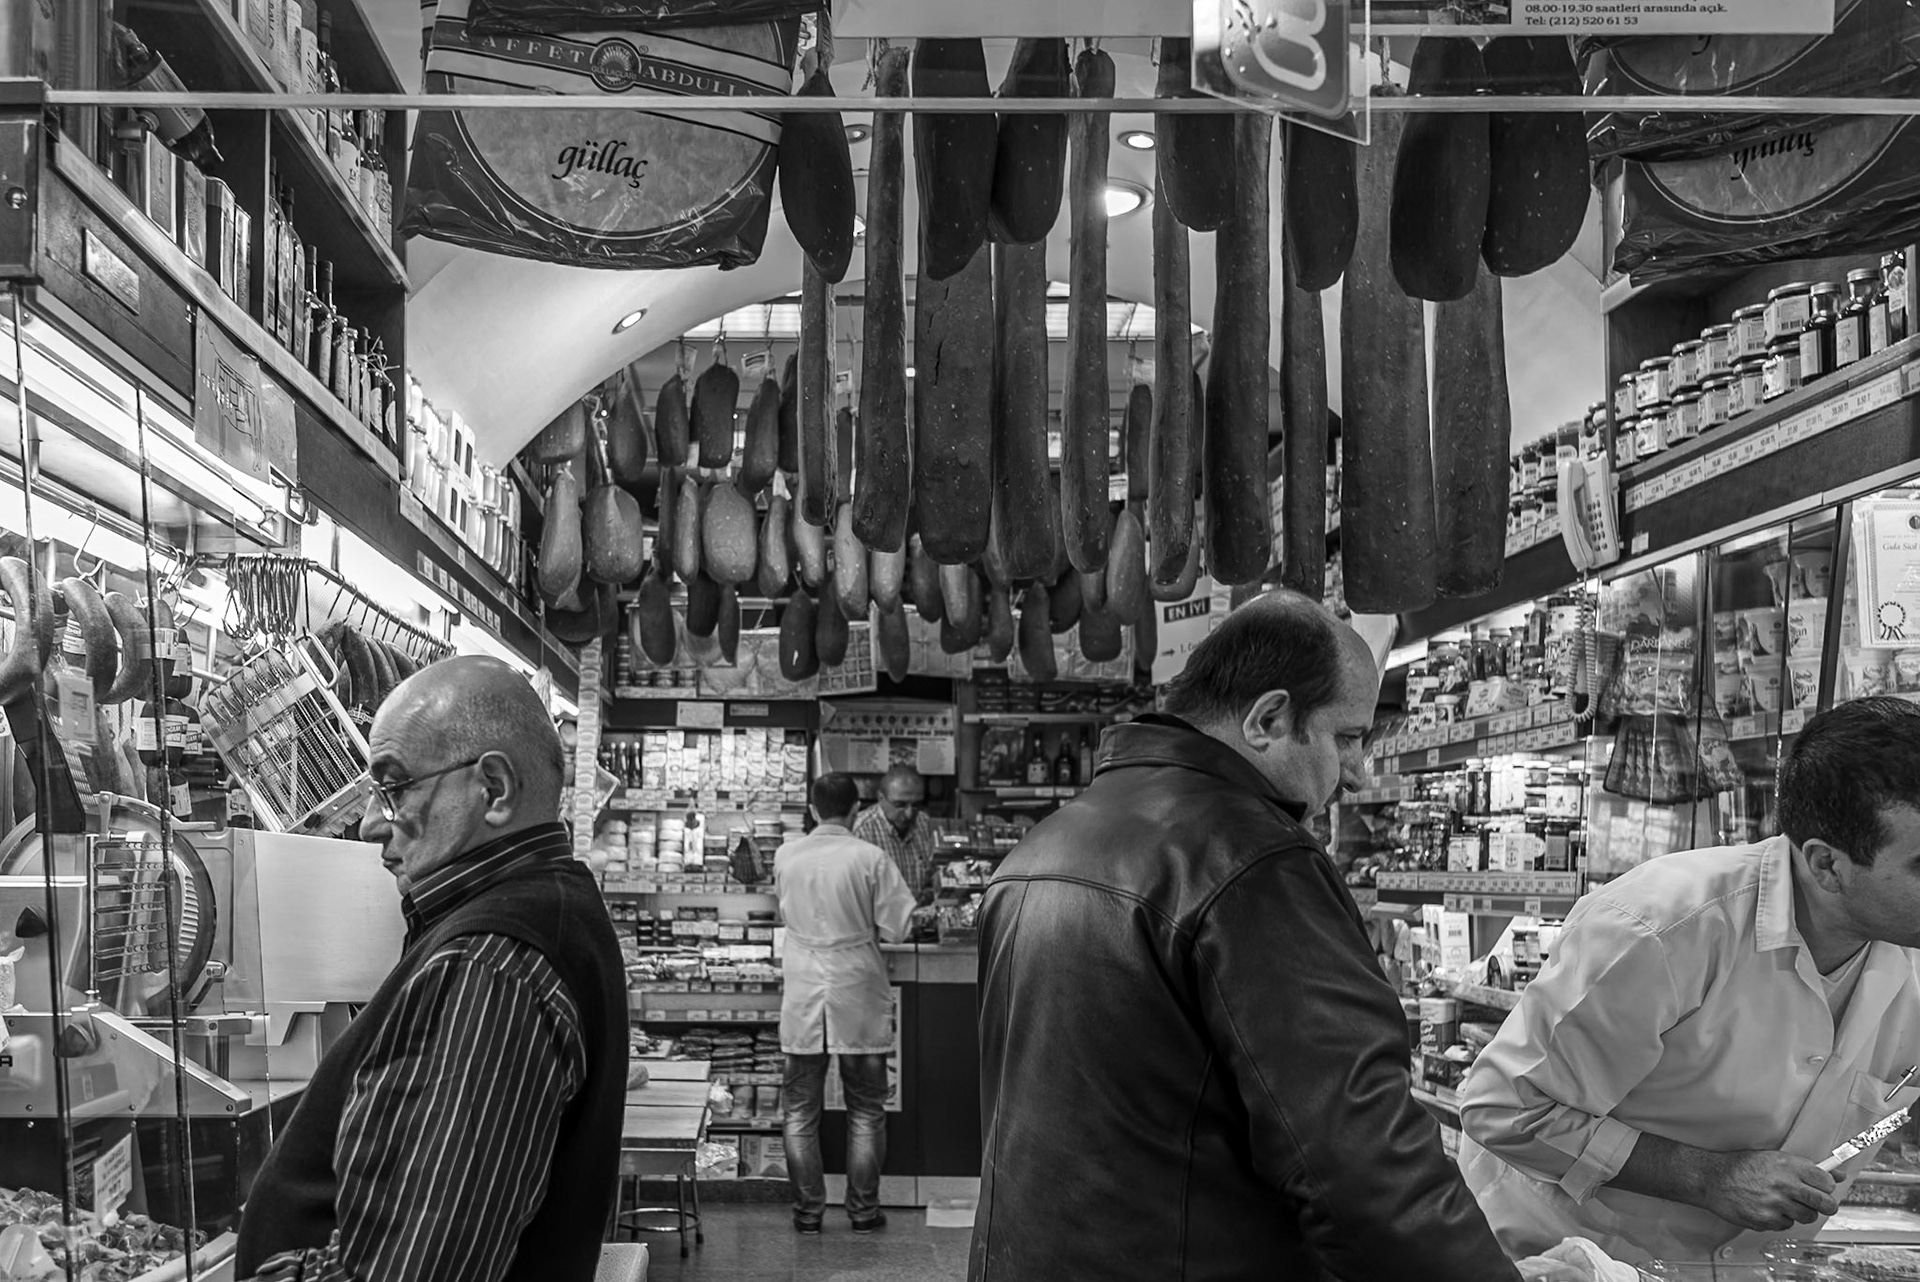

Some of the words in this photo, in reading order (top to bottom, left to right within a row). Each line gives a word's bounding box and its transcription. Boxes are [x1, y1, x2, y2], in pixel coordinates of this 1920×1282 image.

[1525, 4, 1593, 14] 08.00-19.30
[1595, 4, 1641, 14] saatleri
[1643, 4, 1697, 14] arasında
[1699, 4, 1728, 15] açık.
[1524, 16, 1546, 26] Tel:
[1549, 16, 1580, 27] (212)
[1582, 16, 1604, 26] 520
[1606, 16, 1620, 26] 61
[1624, 16, 1639, 26] 53
[458, 28, 585, 64] SAFFET
[552, 140, 649, 188] güllaç
